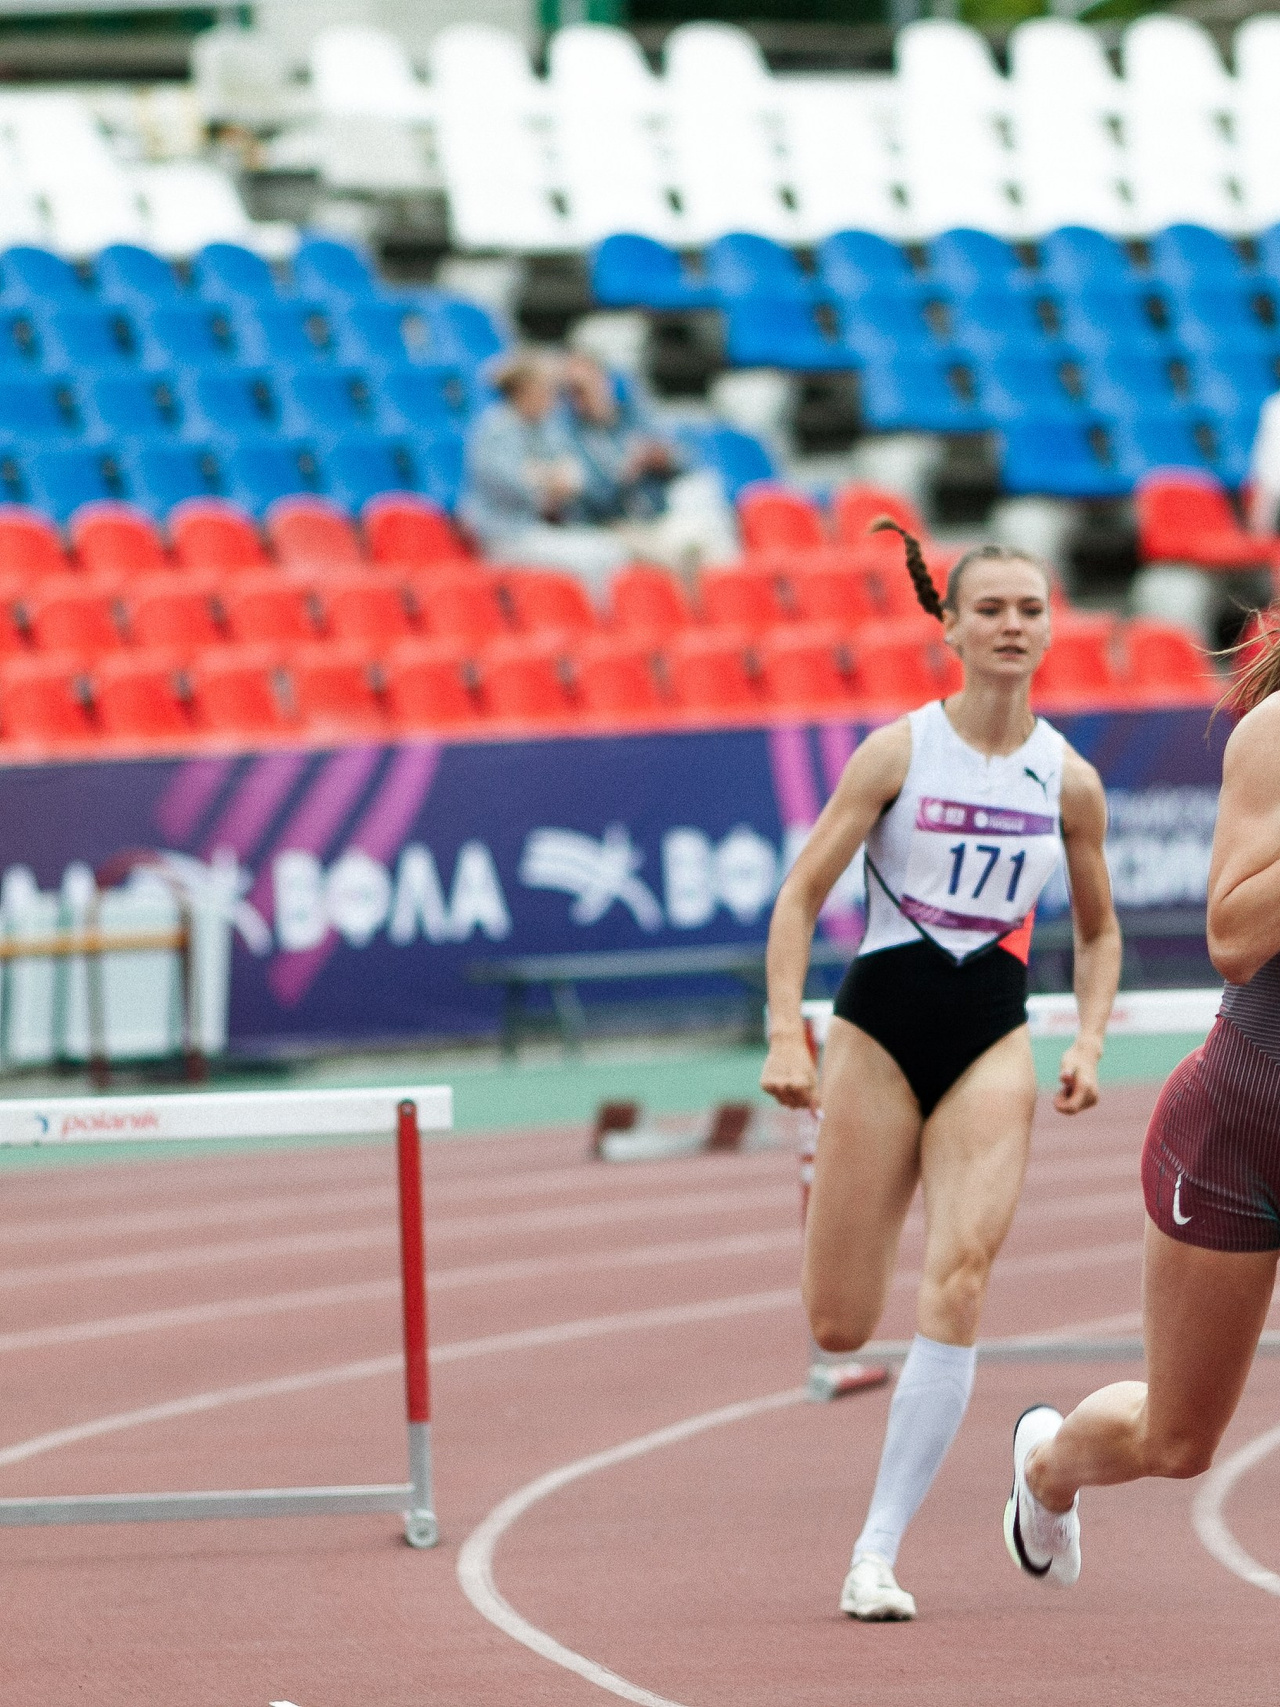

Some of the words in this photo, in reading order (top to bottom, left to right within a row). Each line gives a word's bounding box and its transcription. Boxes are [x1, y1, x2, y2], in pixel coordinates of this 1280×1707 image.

[273, 842, 512, 950] ВФЛА
[662, 824, 808, 928] ВФ
[948, 843, 1026, 902] 171
